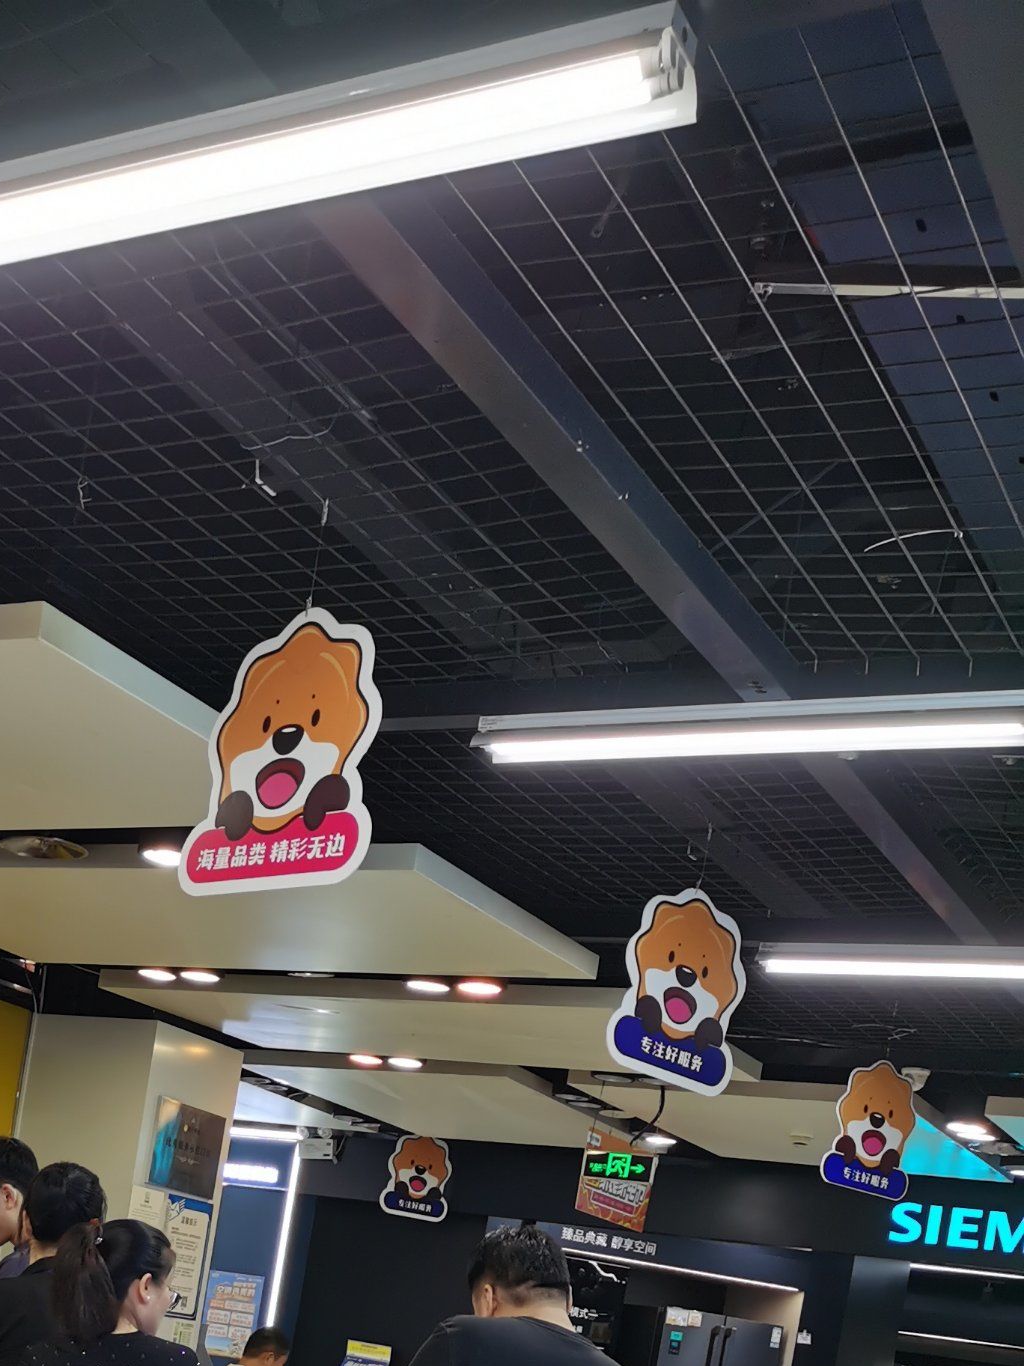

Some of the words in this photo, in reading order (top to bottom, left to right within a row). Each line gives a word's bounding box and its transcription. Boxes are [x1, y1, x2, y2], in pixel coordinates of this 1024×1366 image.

[195, 842, 266, 871] 海量品类
[269, 832, 346, 863] 精彩无边
[640, 1036, 703, 1072] 专注好服务
[842, 1166, 890, 1190] 专注好服务
[888, 1201, 1024, 1254] SIEM
